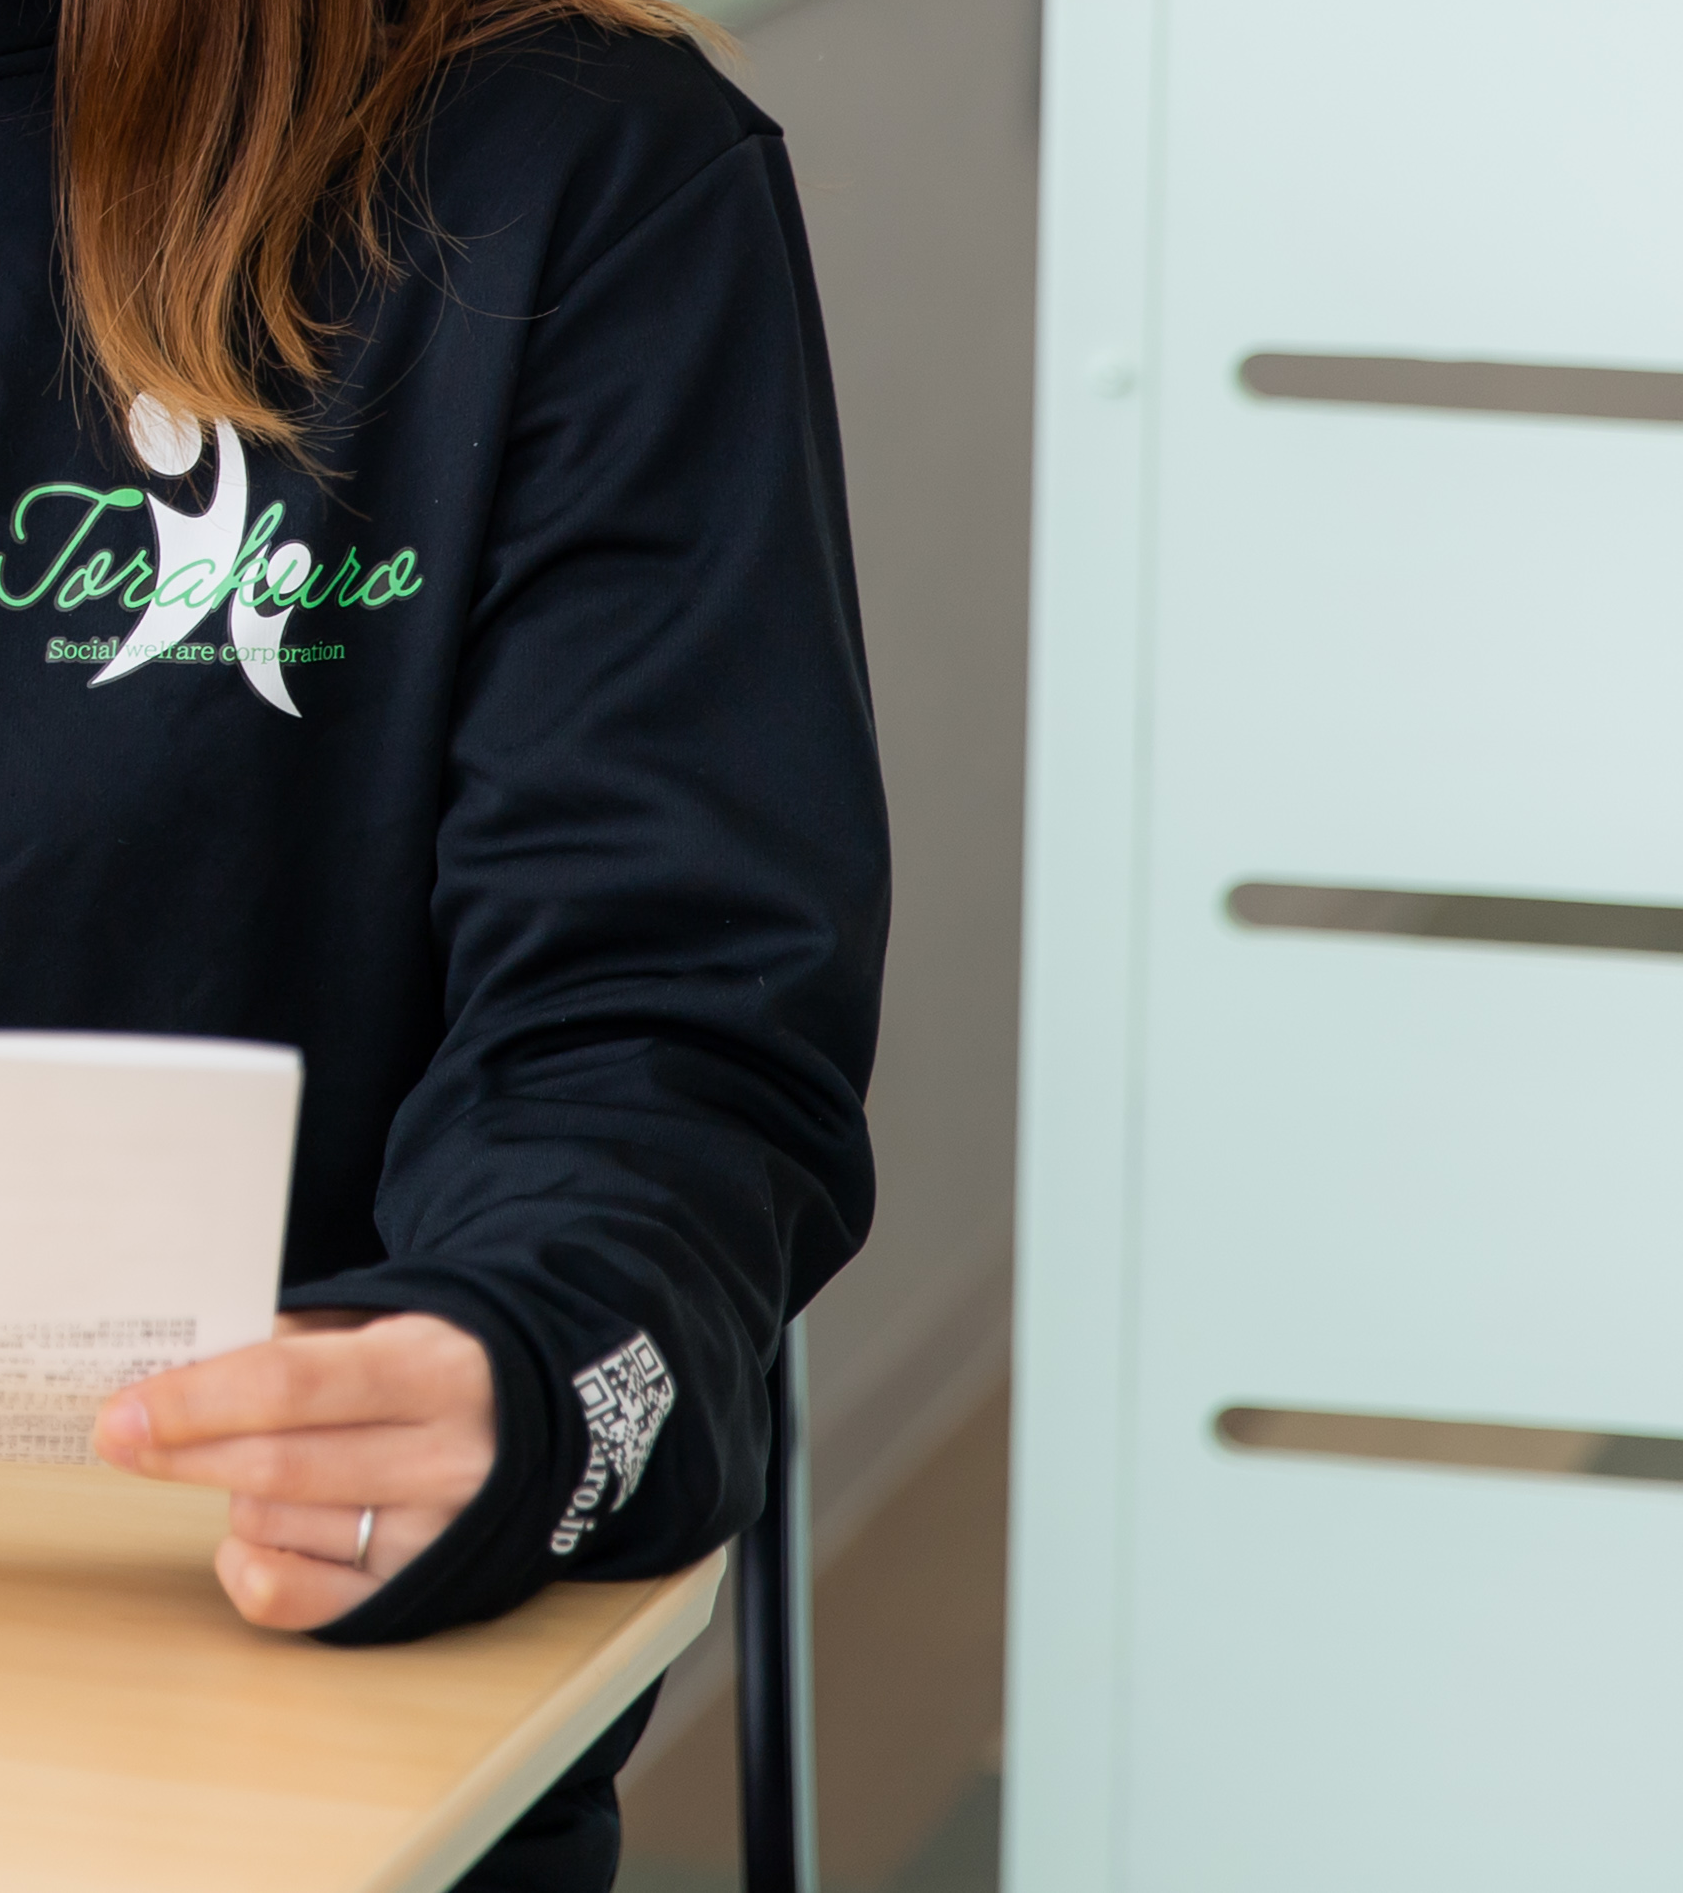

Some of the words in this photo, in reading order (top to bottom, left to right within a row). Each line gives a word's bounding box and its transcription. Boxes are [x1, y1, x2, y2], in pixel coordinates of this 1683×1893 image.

[48, 639, 117, 661] Social
[126, 640, 215, 662] welfare
[221, 641, 345, 665] corporation
